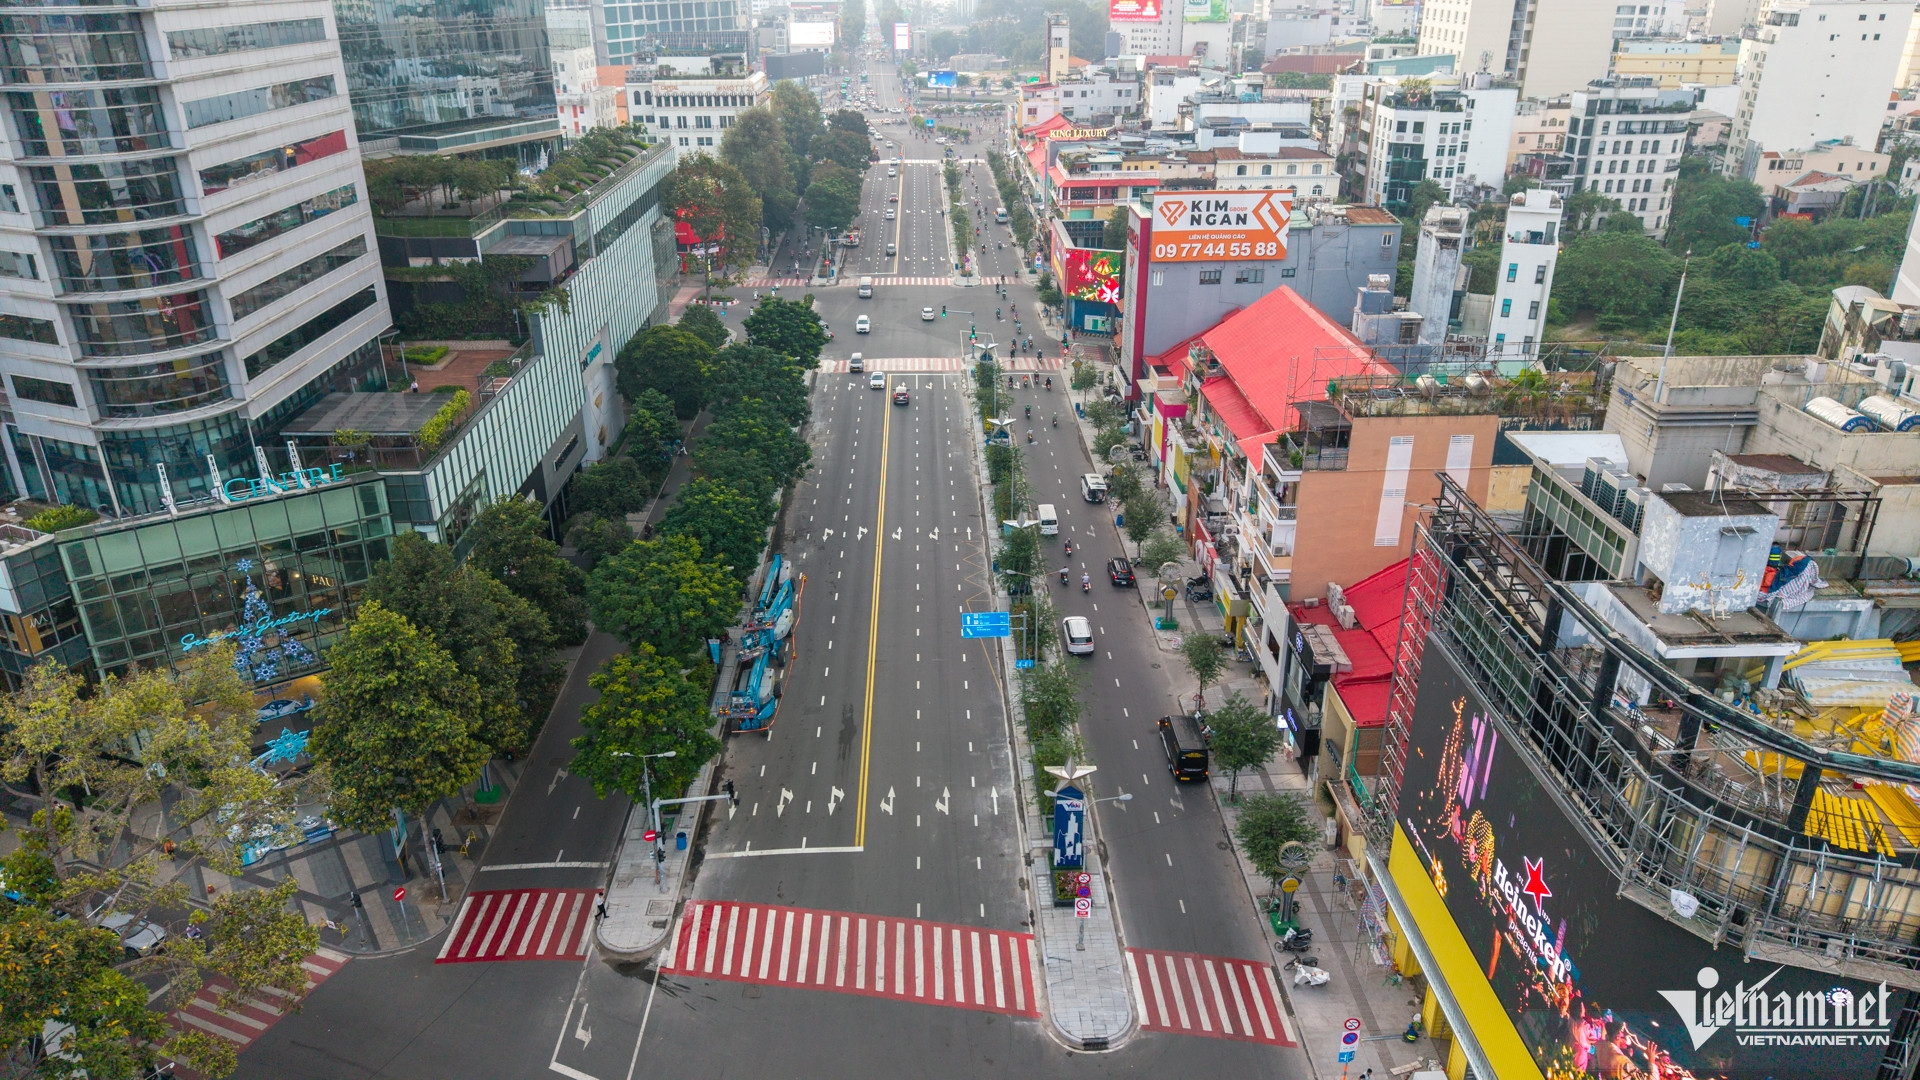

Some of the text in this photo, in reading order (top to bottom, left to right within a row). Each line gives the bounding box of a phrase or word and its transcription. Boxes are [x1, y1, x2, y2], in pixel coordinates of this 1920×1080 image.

[1050, 128, 1108, 138] KING LUXURY
[1192, 200, 1229, 212] KIM
[1189, 213, 1248, 226] NGAN
[1155, 241, 1278, 259] 09 77 44 55 88
[223, 462, 346, 502] CENTRE
[180, 607, 333, 652] Season's Greetings
[1508, 920, 1538, 967] presents
